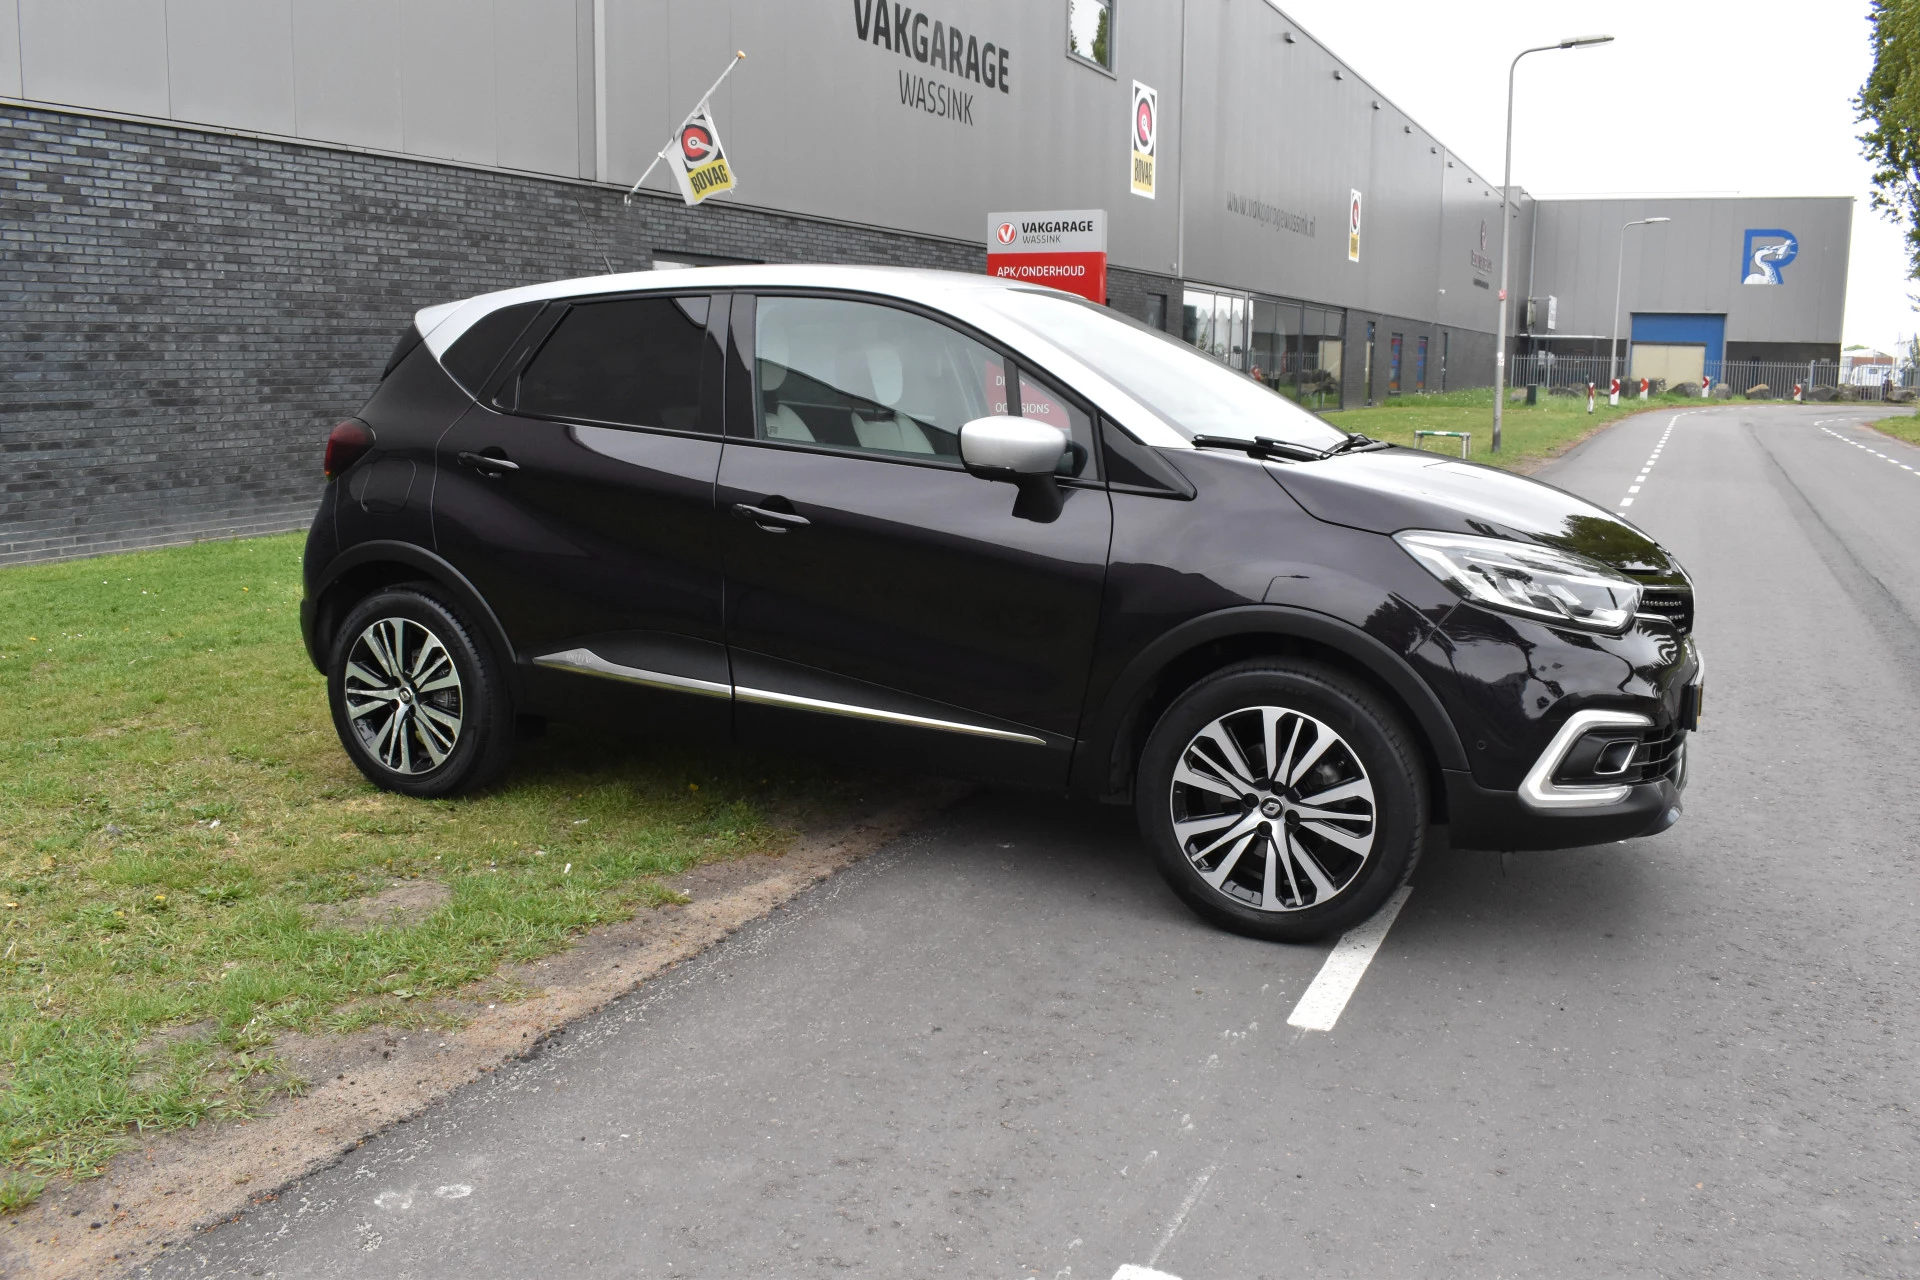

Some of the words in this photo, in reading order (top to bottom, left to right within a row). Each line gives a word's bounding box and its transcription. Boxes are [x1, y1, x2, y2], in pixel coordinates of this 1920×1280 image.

[854, 0, 1009, 94] VAKGARAGE
[899, 69, 973, 126] WASSINK
[691, 164, 729, 194] BOVAG
[1134, 158, 1153, 186] BOVAG
[1022, 220, 1094, 233] VAKGARAGE
[1022, 235, 1061, 244] WASSINK
[997, 265, 1085, 278] APK/ONDERHOUD
[995, 402, 1050, 414] OCSIONS
